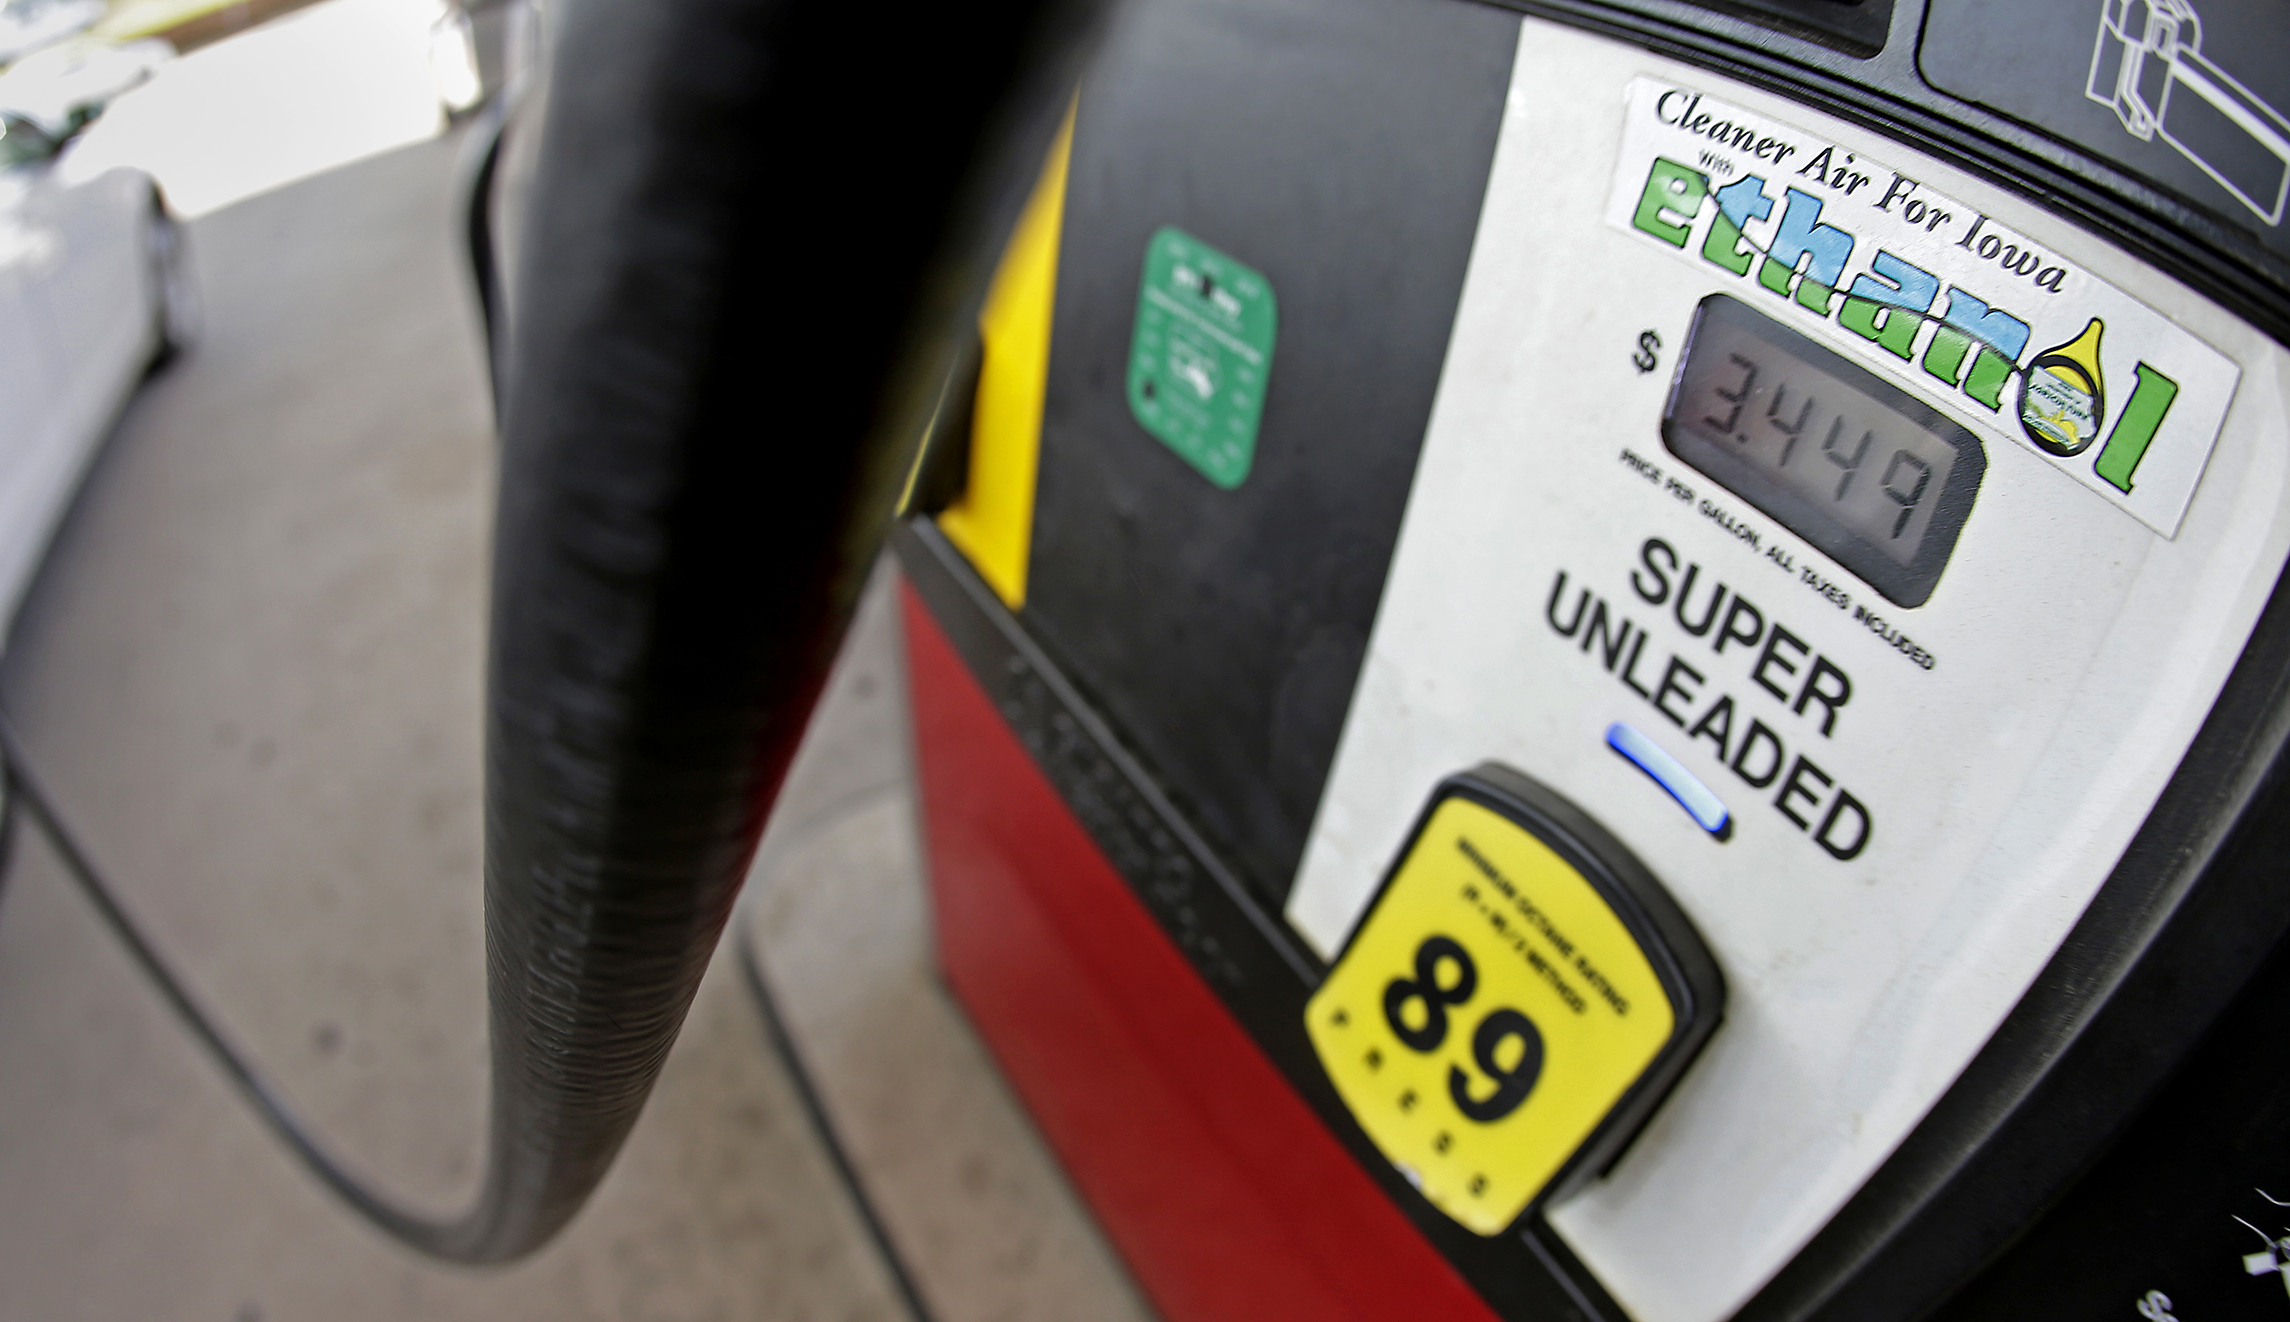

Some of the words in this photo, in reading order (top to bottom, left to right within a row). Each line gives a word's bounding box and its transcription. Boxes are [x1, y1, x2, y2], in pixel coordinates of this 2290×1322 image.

[1657, 89, 1795, 165] Cleaner
[1796, 144, 1869, 197] Air
[1873, 171, 1950, 232] For
[1955, 213, 2068, 293] Iowa
[1632, 155, 2179, 496] ethanol
[1632, 329, 1662, 374] $
[1702, 352, 1933, 540] 3.449
[1619, 448, 1663, 485] PRICE
[1665, 476, 1696, 506] PER
[1765, 545, 1795, 574] ALL
[1800, 565, 1851, 610] TAXES
[1853, 603, 1935, 671] INCLUDED
[1630, 537, 1853, 738] SUPER
[1546, 569, 1872, 862] UNLEADED
[1382, 933, 1546, 1128] 89
